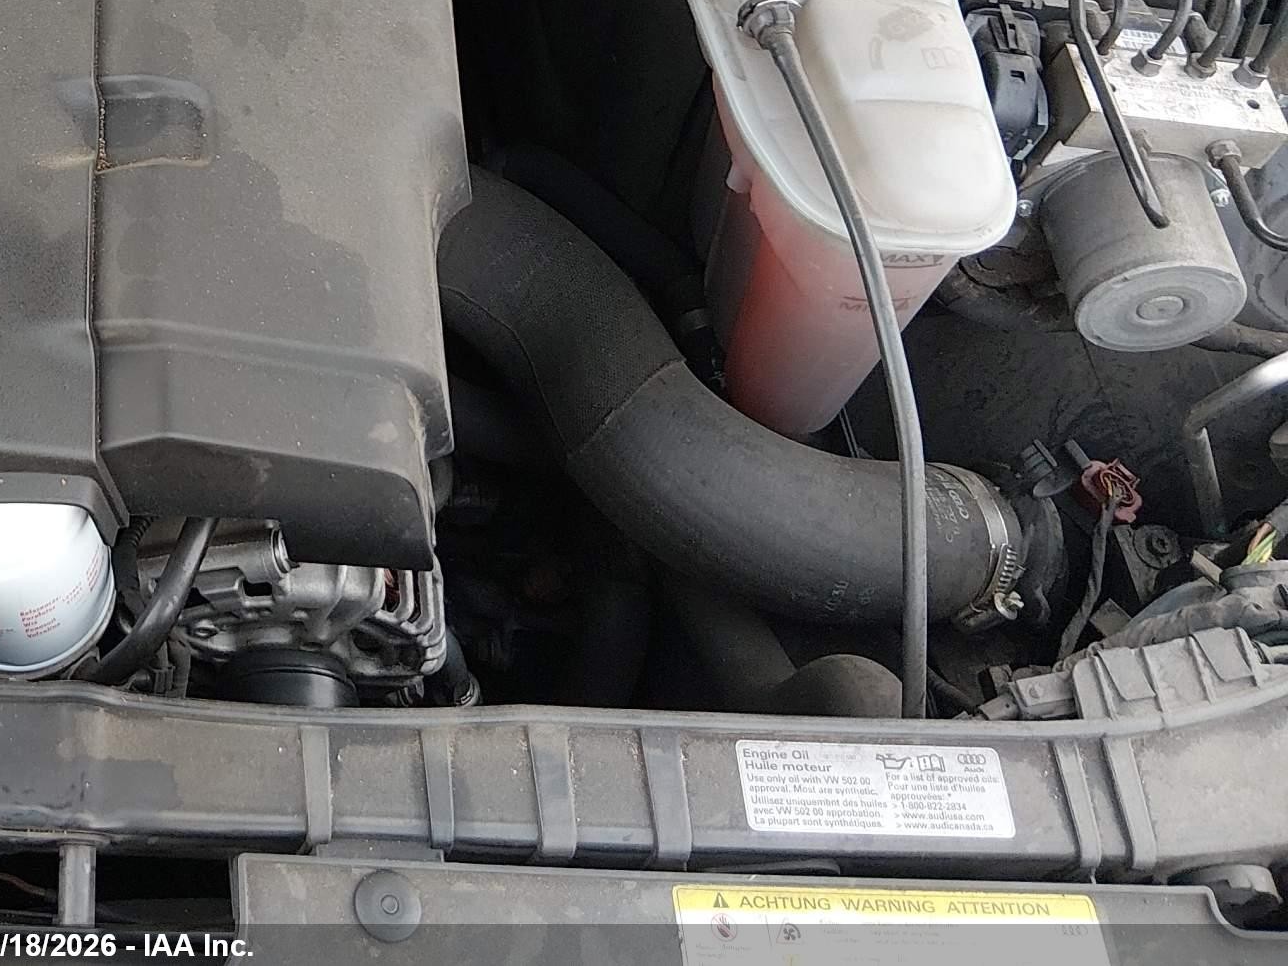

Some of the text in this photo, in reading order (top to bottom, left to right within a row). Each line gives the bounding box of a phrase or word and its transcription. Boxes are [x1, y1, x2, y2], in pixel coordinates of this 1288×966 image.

[743, 749, 809, 760] Engine Oil
[745, 761, 832, 772] Huile moteur
[747, 774, 871, 786] Use only oil with VW 502 00
[886, 773, 900, 781] For
[910, 773, 924, 782] list
[926, 774, 935, 782] of
[938, 775, 979, 784] approved
[749, 784, 791, 794] approval.
[793, 785, 816, 794] Most
[888, 782, 909, 791] Pour
[930, 783, 949, 792] liste
[951, 783, 986, 793] d'huiles
[751, 795, 888, 808] Utilisez uniquement des huiles
[901, 801, 967, 811] 1-800-822-2834
[776, 806, 792, 815] VW
[794, 807, 811, 816] 502
[812, 807, 824, 816] 00
[826, 808, 882, 819] approbation.
[902, 812, 985, 822] www.audiusa.com
[754, 816, 765, 825] La
[768, 817, 800, 827] plupart
[803, 818, 822, 826] sont
[904, 820, 994, 831] www.audicanada.ca
[739, 895, 1051, 916] ACHTUNG WARNING ATTENTION
